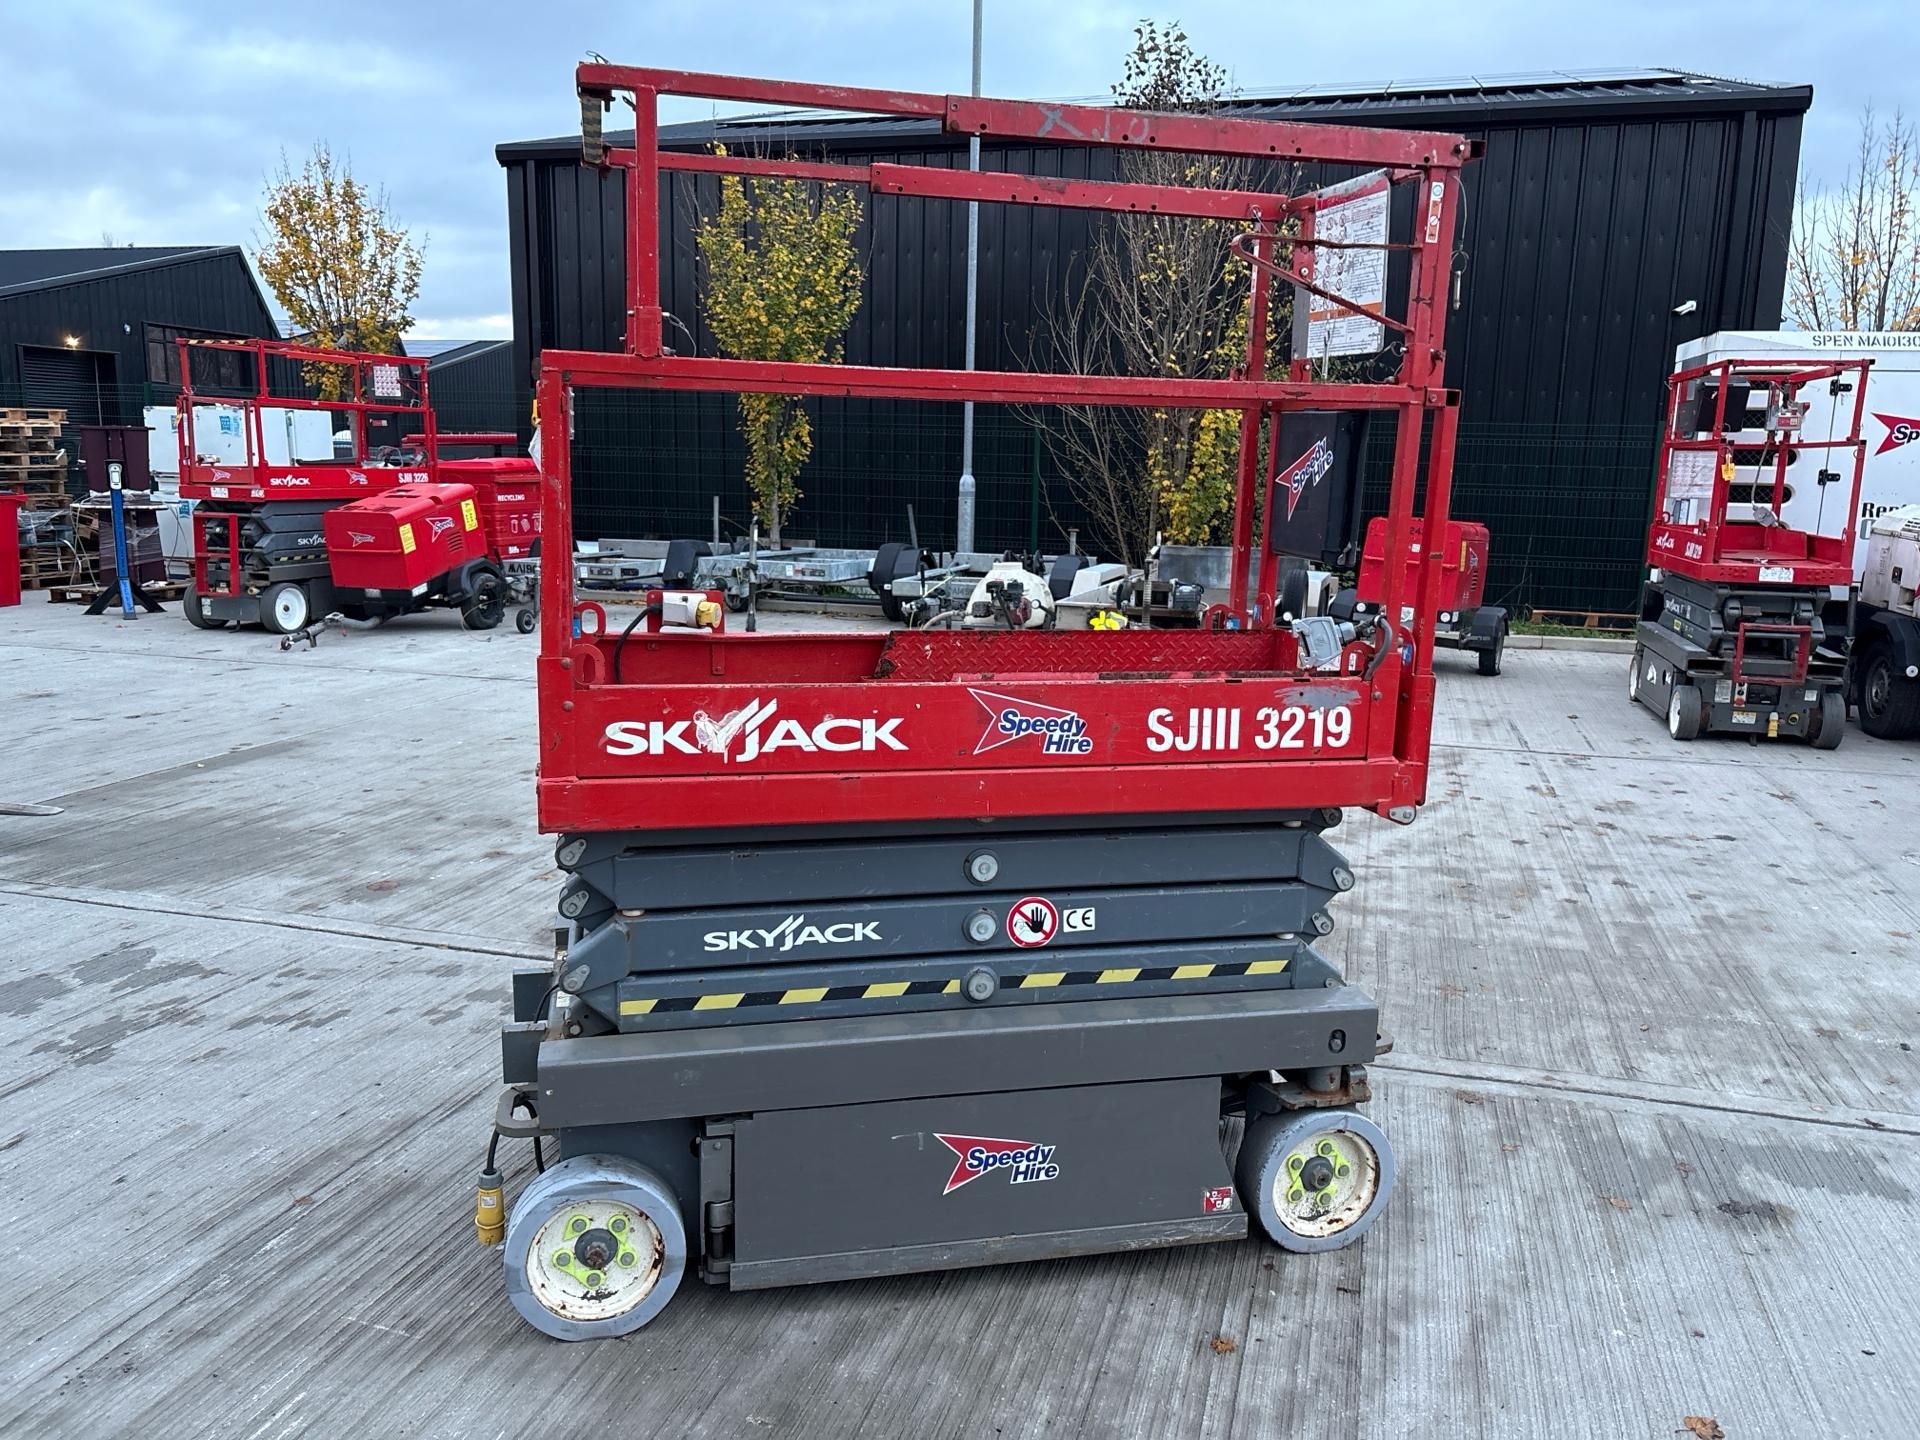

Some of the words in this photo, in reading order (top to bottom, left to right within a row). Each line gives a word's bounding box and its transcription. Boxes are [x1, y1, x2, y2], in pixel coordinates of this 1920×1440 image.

[1812, 335, 1854, 347] SPEN
[1291, 437, 1327, 492] Speedy
[1313, 450, 1334, 487] Hire
[269, 474, 311, 488] SKYJACK
[497, 494, 525, 502] RECYCLING
[605, 697, 910, 764] SKYJACK
[1254, 705, 1352, 748] 3219
[998, 708, 1087, 740] Speedy
[1043, 732, 1093, 754] Hire
[1065, 909, 1095, 930] CE
[703, 913, 882, 952] SKYJACK
[966, 1144, 1055, 1172] Speedy
[1011, 1162, 1060, 1184] Hire
